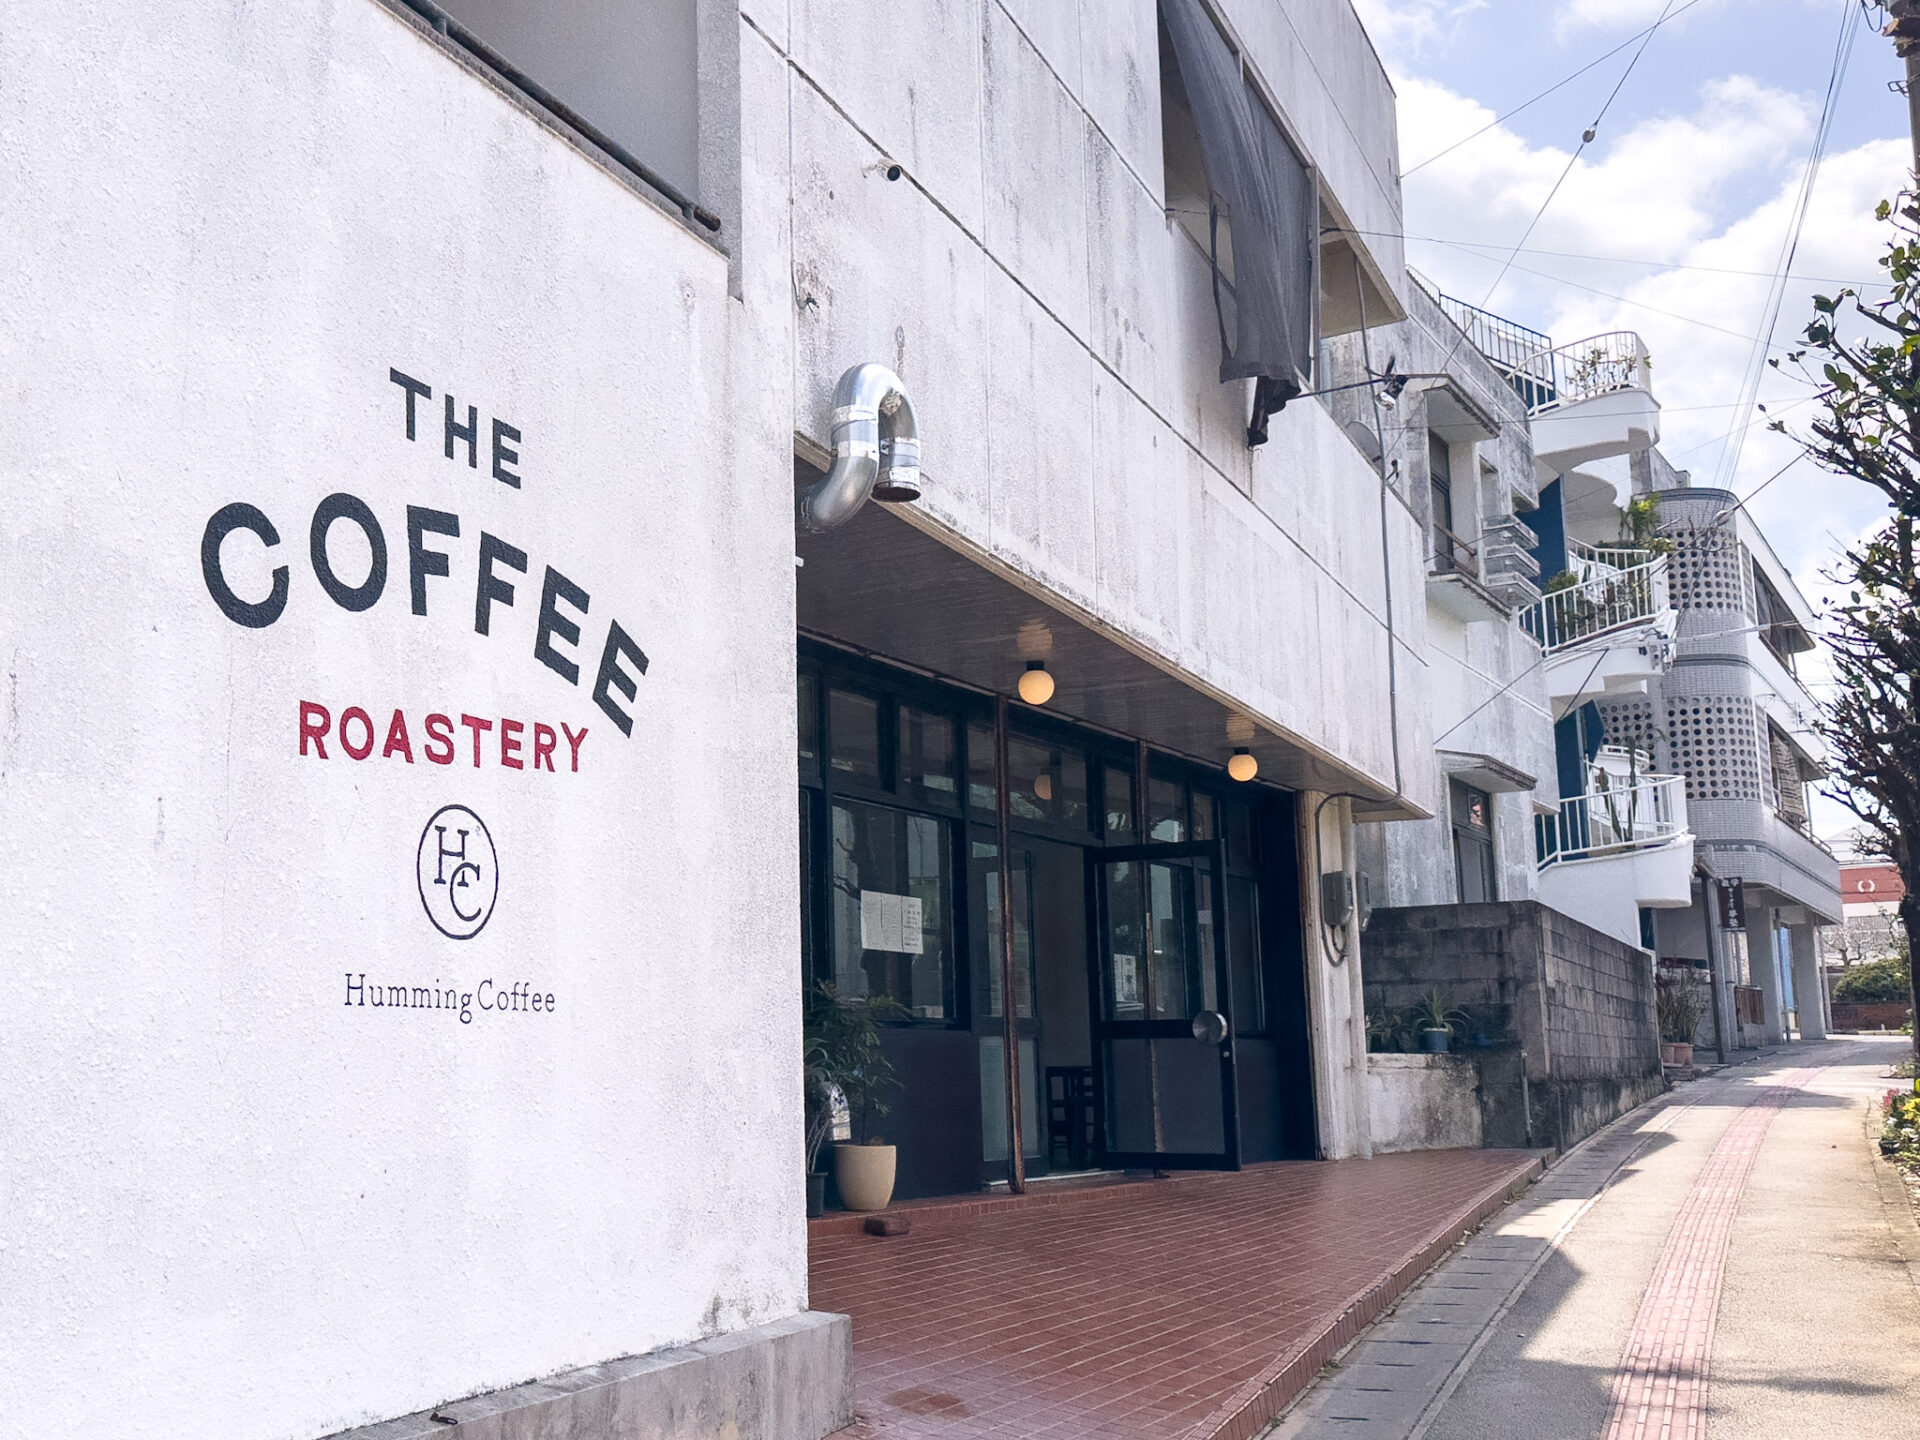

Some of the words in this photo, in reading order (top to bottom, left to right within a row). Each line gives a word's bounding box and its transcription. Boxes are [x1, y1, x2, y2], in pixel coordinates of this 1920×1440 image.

[389, 366, 522, 490] THE
[200, 491, 650, 739] COFFEE
[298, 699, 589, 774] ROASTERY
